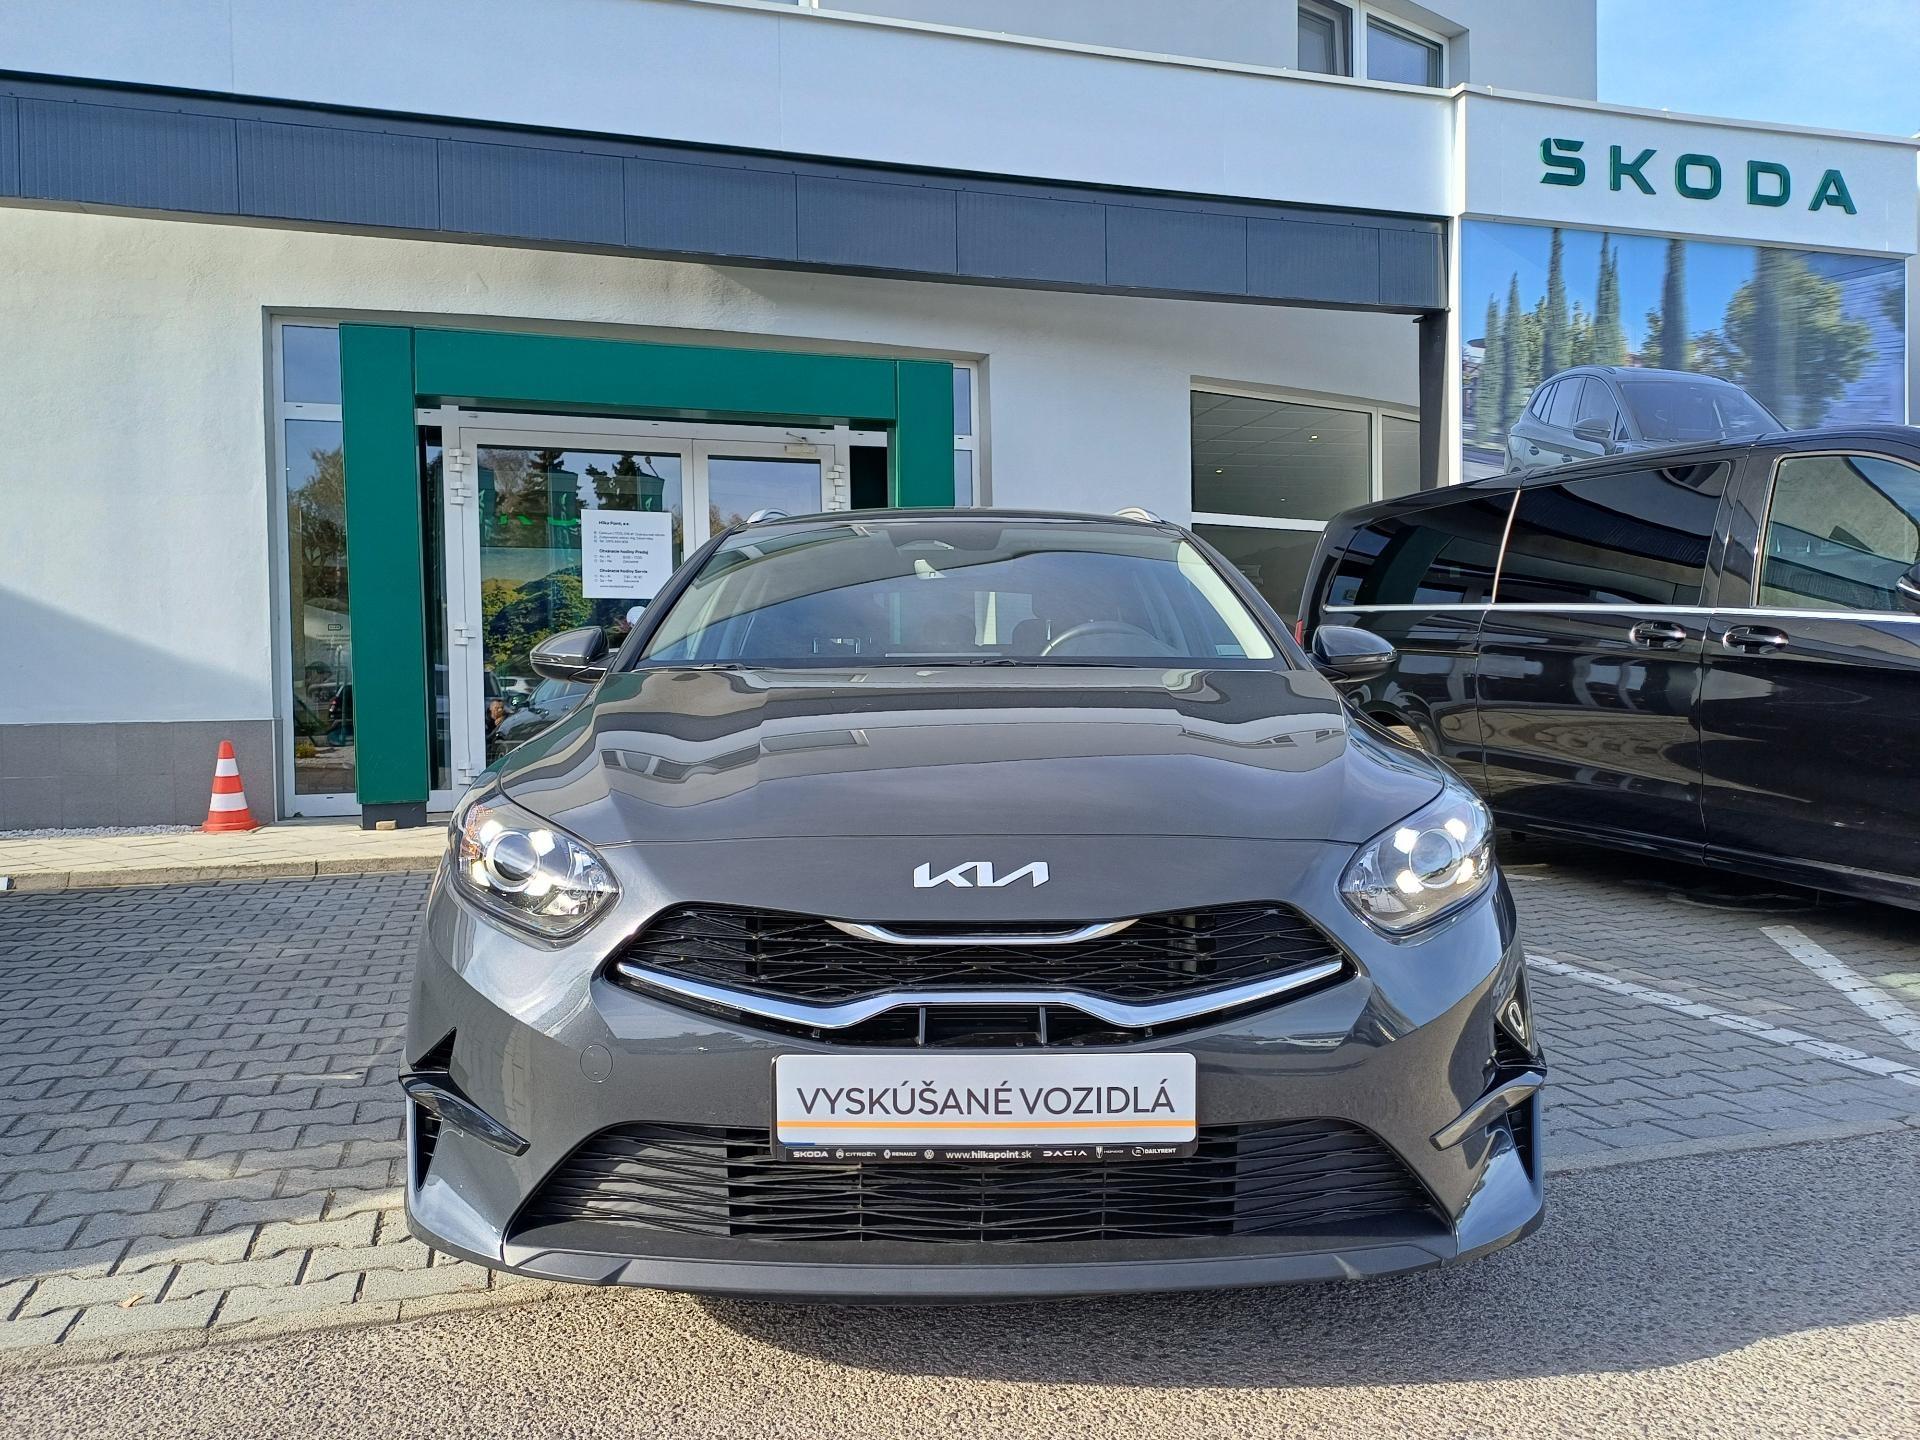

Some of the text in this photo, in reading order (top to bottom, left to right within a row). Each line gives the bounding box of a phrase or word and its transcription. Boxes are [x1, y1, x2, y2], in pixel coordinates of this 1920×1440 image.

[796, 1079, 1176, 1115] VYSKÚŠANÉ VOZIDLÁ
[946, 1150, 1032, 1160] www.hilkapoint.sk
